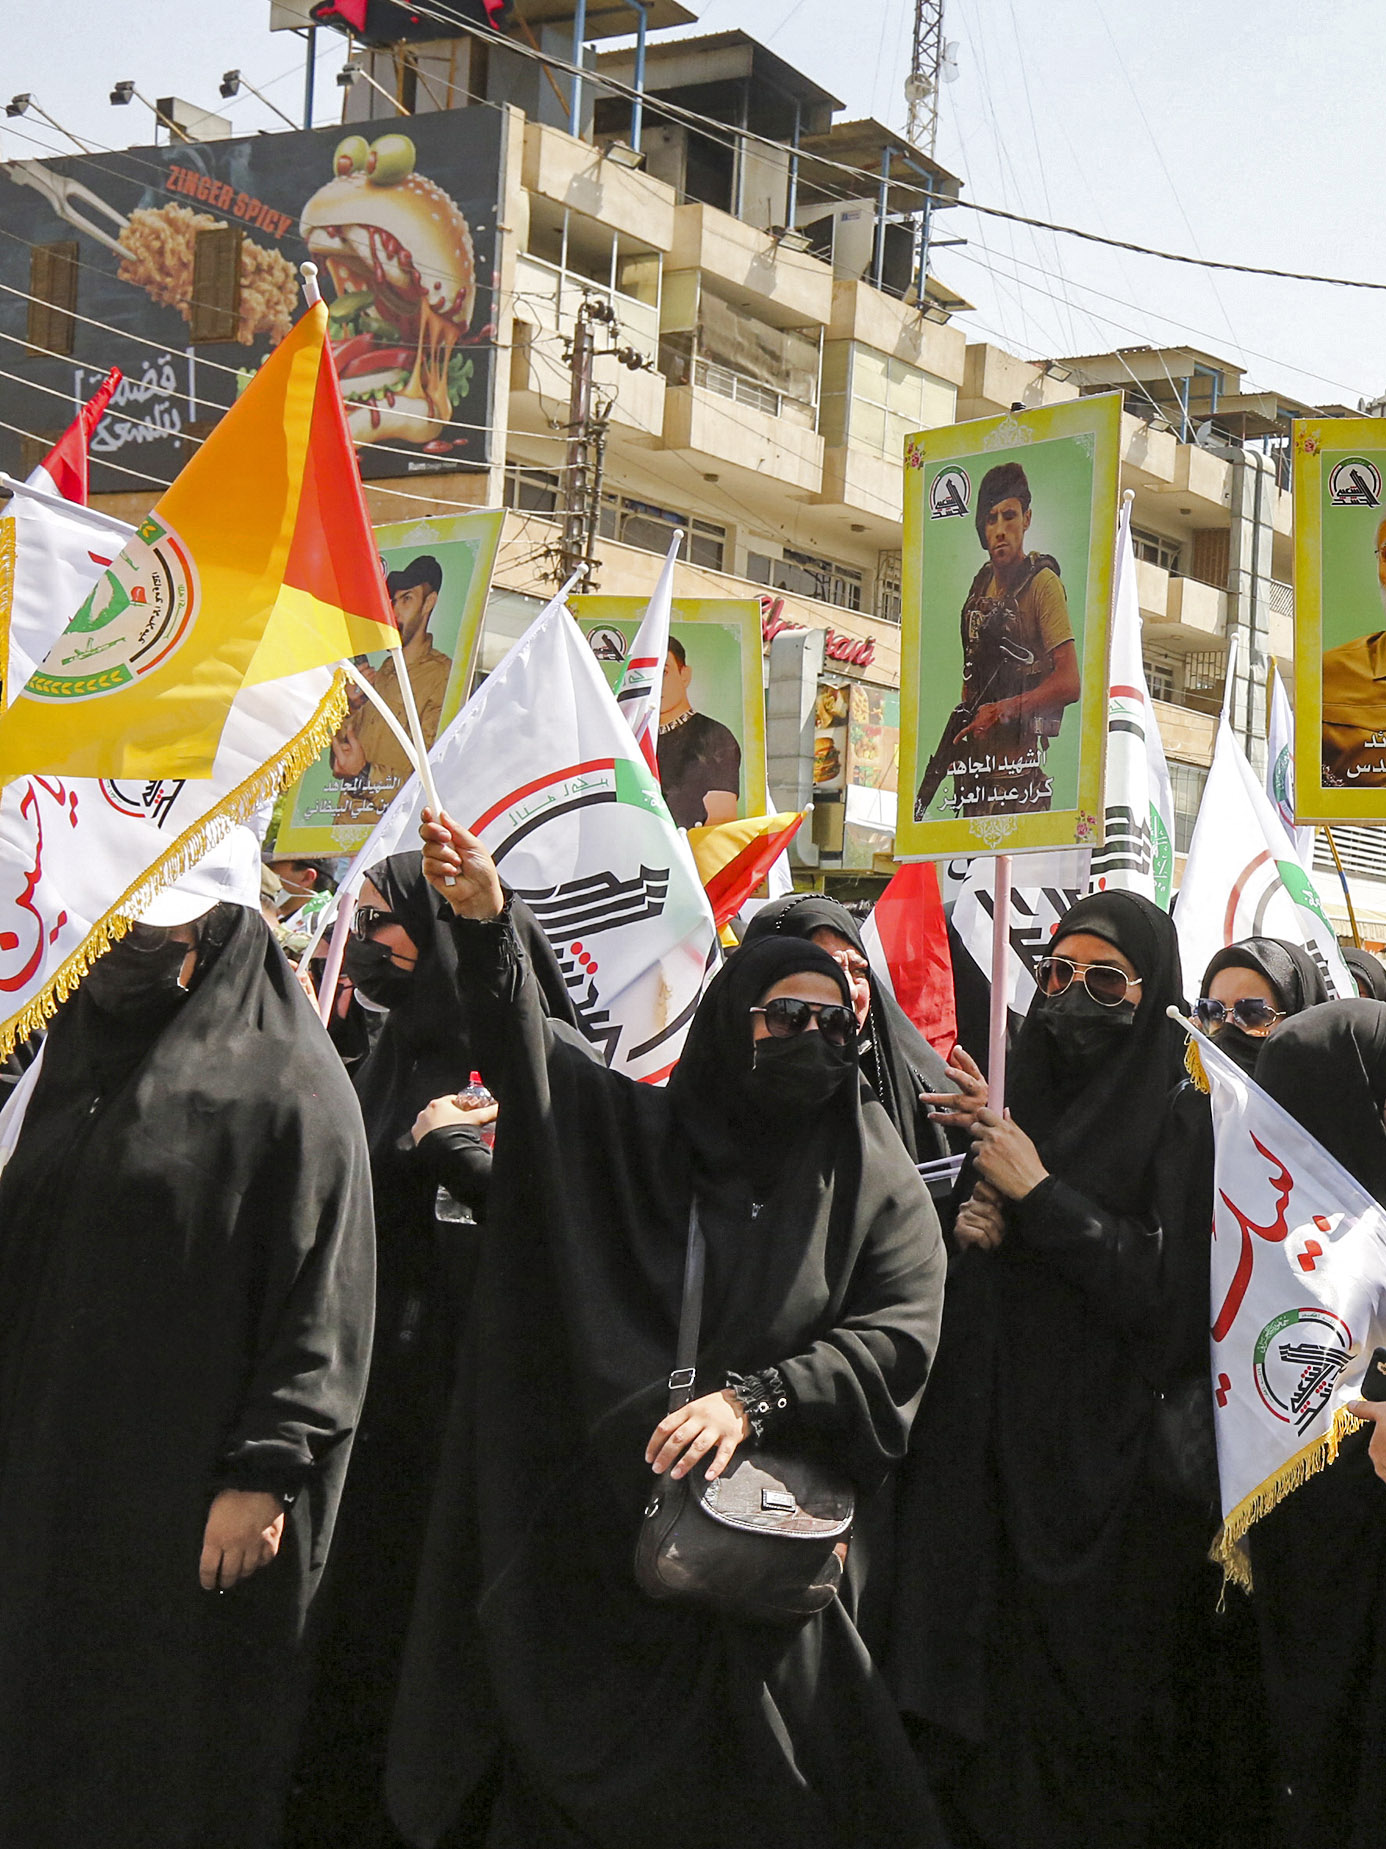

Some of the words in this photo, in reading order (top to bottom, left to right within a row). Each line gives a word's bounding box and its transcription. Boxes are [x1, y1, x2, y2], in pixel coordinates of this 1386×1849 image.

[166, 164, 234, 211] ZINGER
[233, 192, 293, 239] SPICY
[946, 754, 996, 779] المجاهد
[998, 749, 1046, 775] الشهيد
[323, 778, 362, 795] المجاهد
[362, 775, 401, 794] الشهيد
[987, 787, 1019, 806] عبد
[1018, 777, 1054, 804] كرار
[351, 799, 374, 818] علي
[938, 786, 985, 811] العزيز
